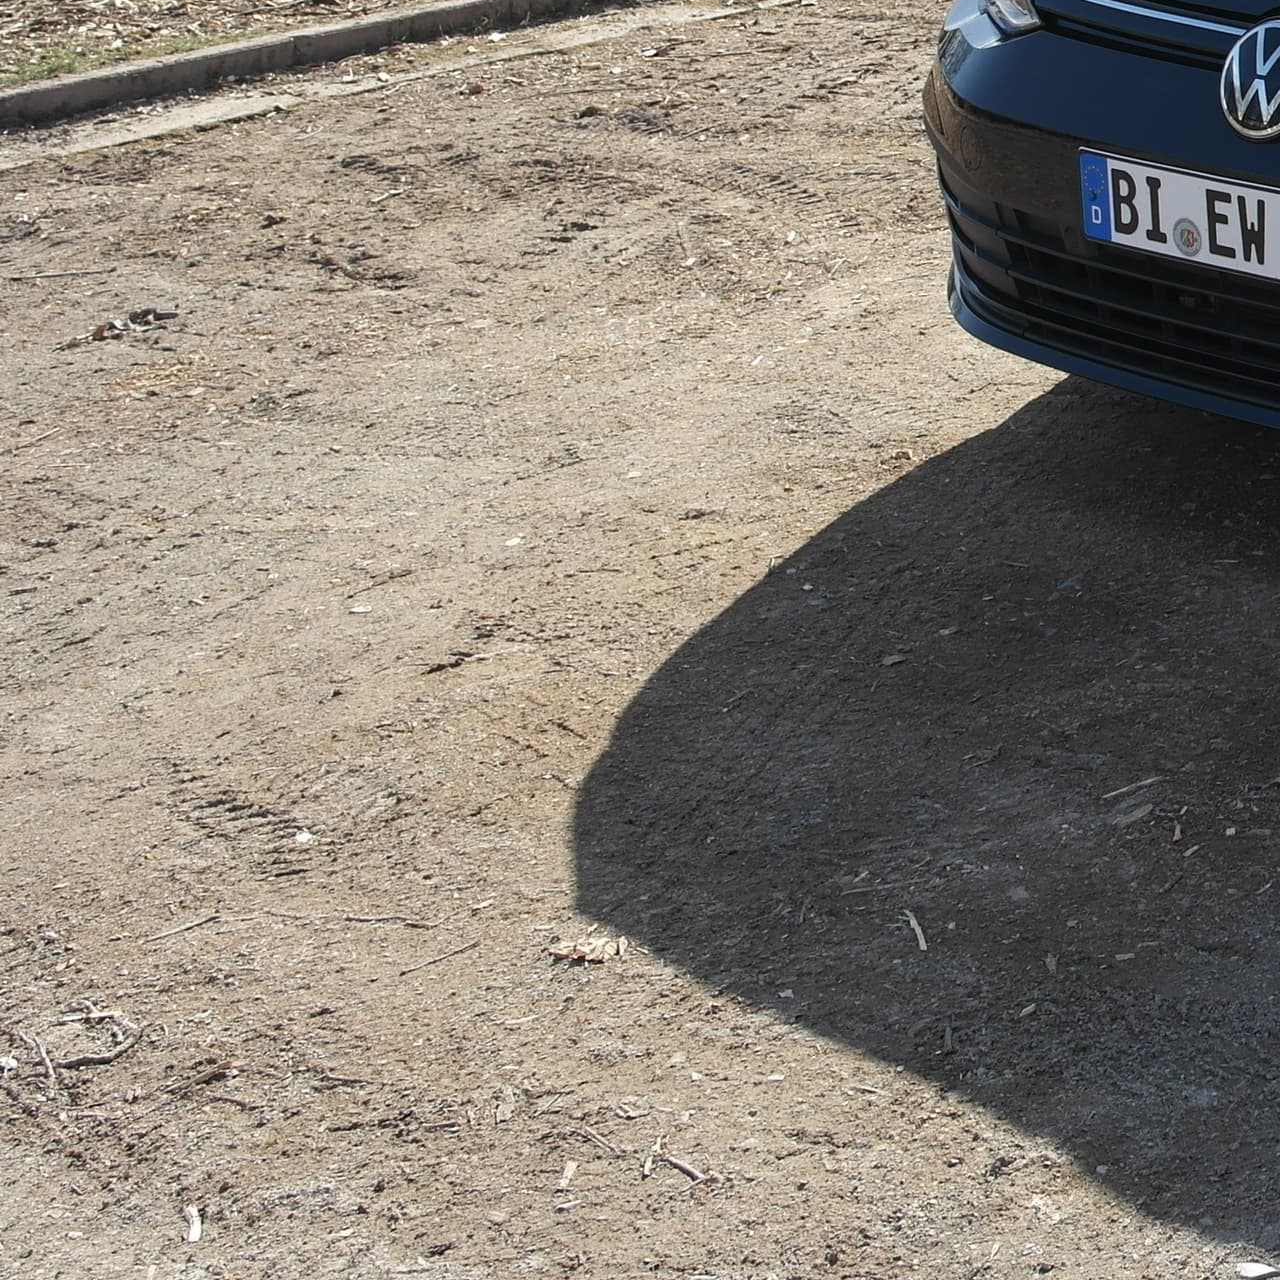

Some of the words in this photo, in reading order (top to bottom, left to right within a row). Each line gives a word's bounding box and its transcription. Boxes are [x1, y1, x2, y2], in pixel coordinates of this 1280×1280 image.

[1091, 205, 1102, 224] D
[1110, 167, 1168, 245] BI
[1205, 188, 1266, 266] EW
